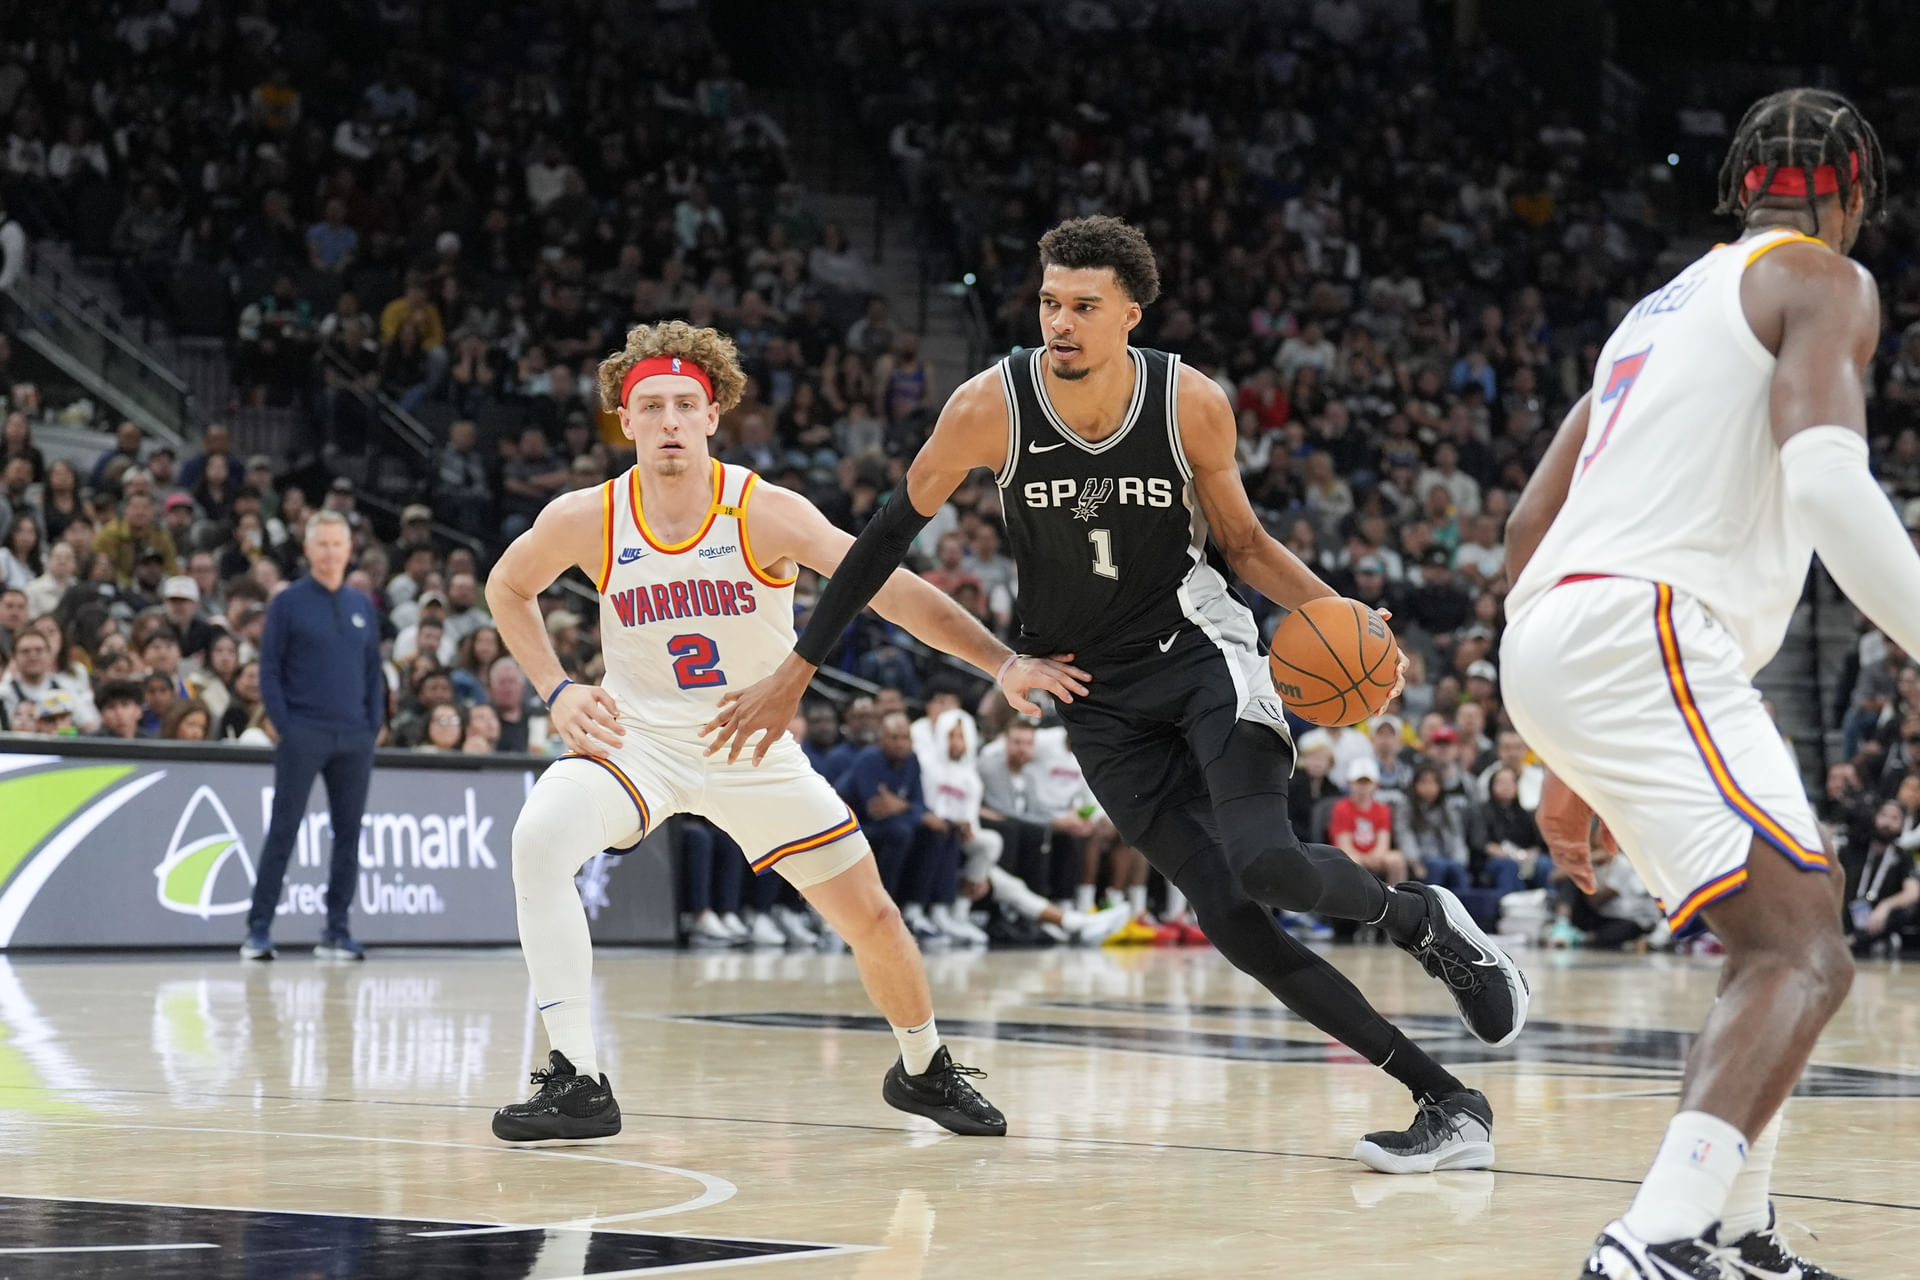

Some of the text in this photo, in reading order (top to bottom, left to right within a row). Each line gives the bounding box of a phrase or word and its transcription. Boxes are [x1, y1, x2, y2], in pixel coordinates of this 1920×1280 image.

[1579, 343, 1654, 479] 7
[1024, 477, 1172, 521] SPURS
[621, 547, 642, 559] NIKE
[698, 545, 738, 559] Rakuten
[1088, 528, 1118, 580] 1
[610, 579, 756, 628] WARRIORS
[666, 633, 727, 690] 2
